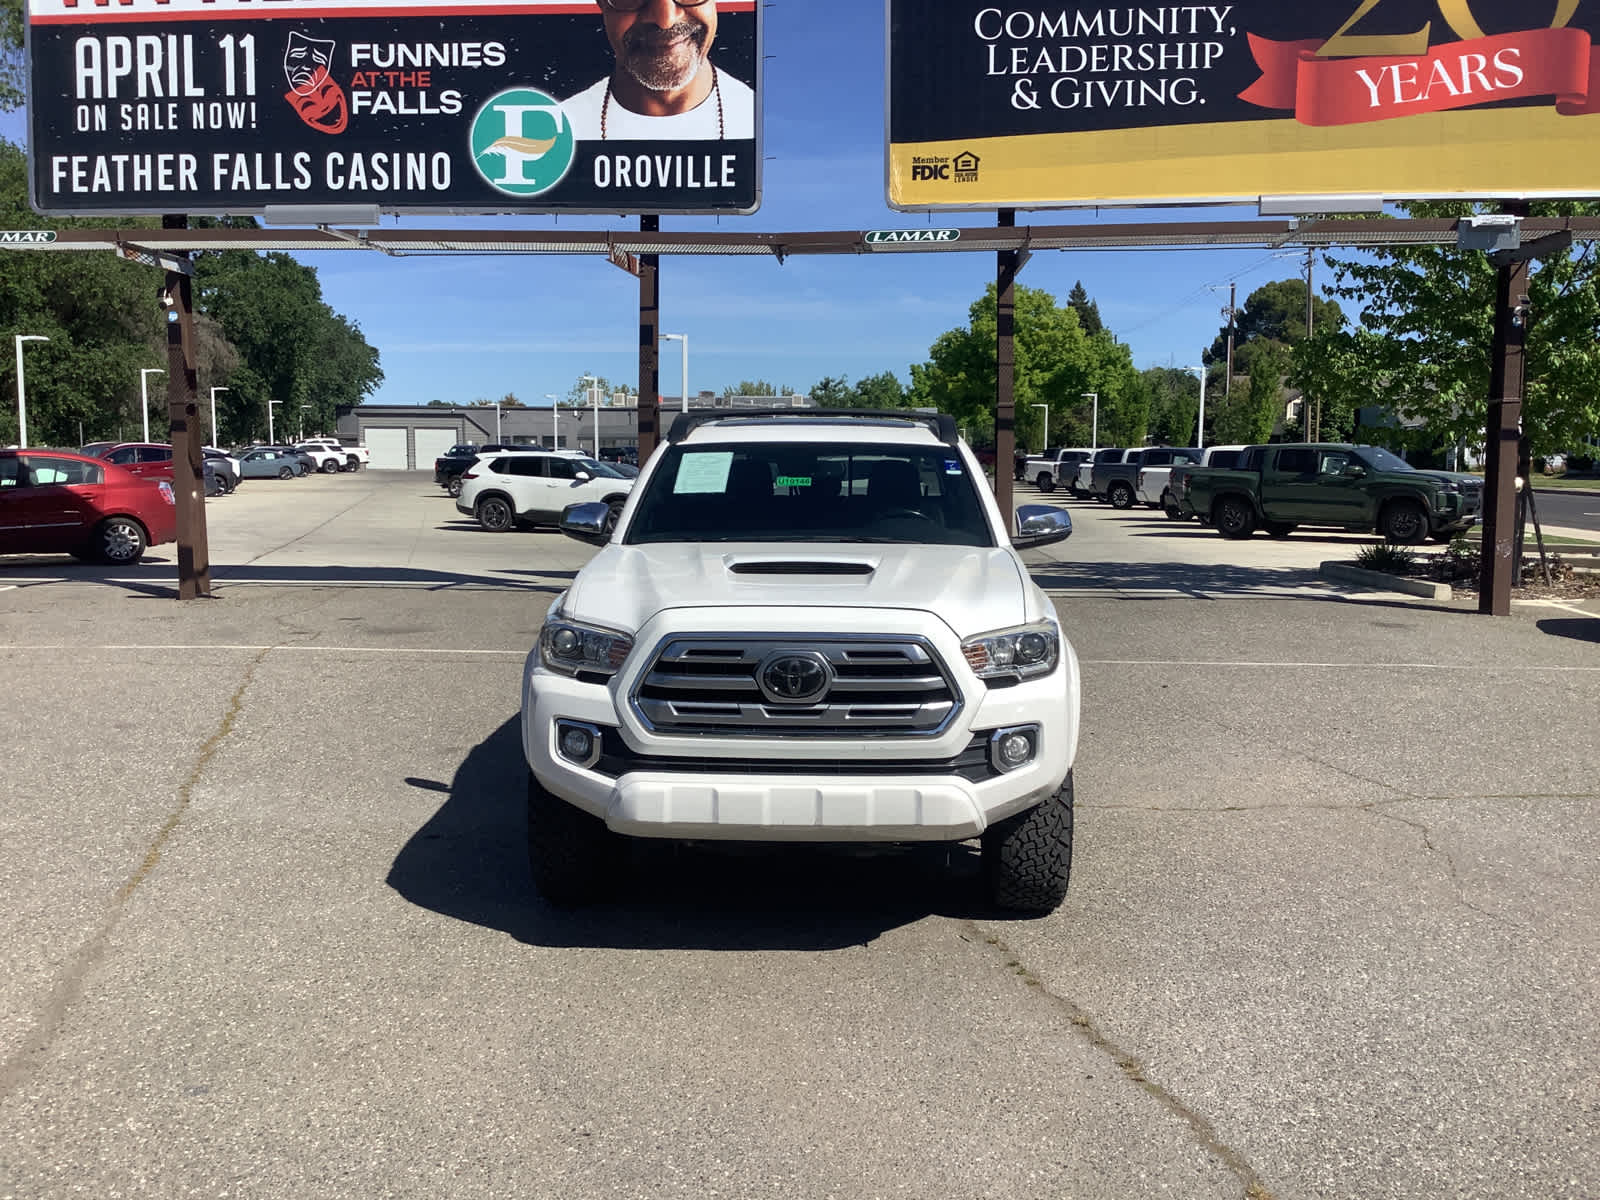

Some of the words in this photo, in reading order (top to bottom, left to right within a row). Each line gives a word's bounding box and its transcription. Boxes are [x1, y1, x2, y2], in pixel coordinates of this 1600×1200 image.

[974, 5, 1237, 40] COMMUNITY,
[75, 34, 205, 99] APRIL
[218, 33, 256, 96] 11
[351, 42, 506, 68] FUNNIES
[986, 41, 1224, 76] LEADERSHIP
[351, 71, 380, 87] AT
[384, 71, 431, 87] THE
[1355, 47, 1524, 108] YEARS
[352, 90, 462, 115] FALLS
[1010, 78, 1043, 110] &
[1050, 77, 1206, 109] GIVING.
[76, 104, 107, 131] ON
[120, 103, 178, 131] SALE
[192, 102, 256, 129] NOW!
[52, 153, 198, 193] FEATHER
[213, 152, 312, 191] FALLS
[326, 151, 451, 191] CASINO
[593, 154, 736, 188] OROVILLE
[912, 156, 949, 164] Member
[912, 164, 950, 180] FDIC
[873, 230, 951, 242] LAMAR
